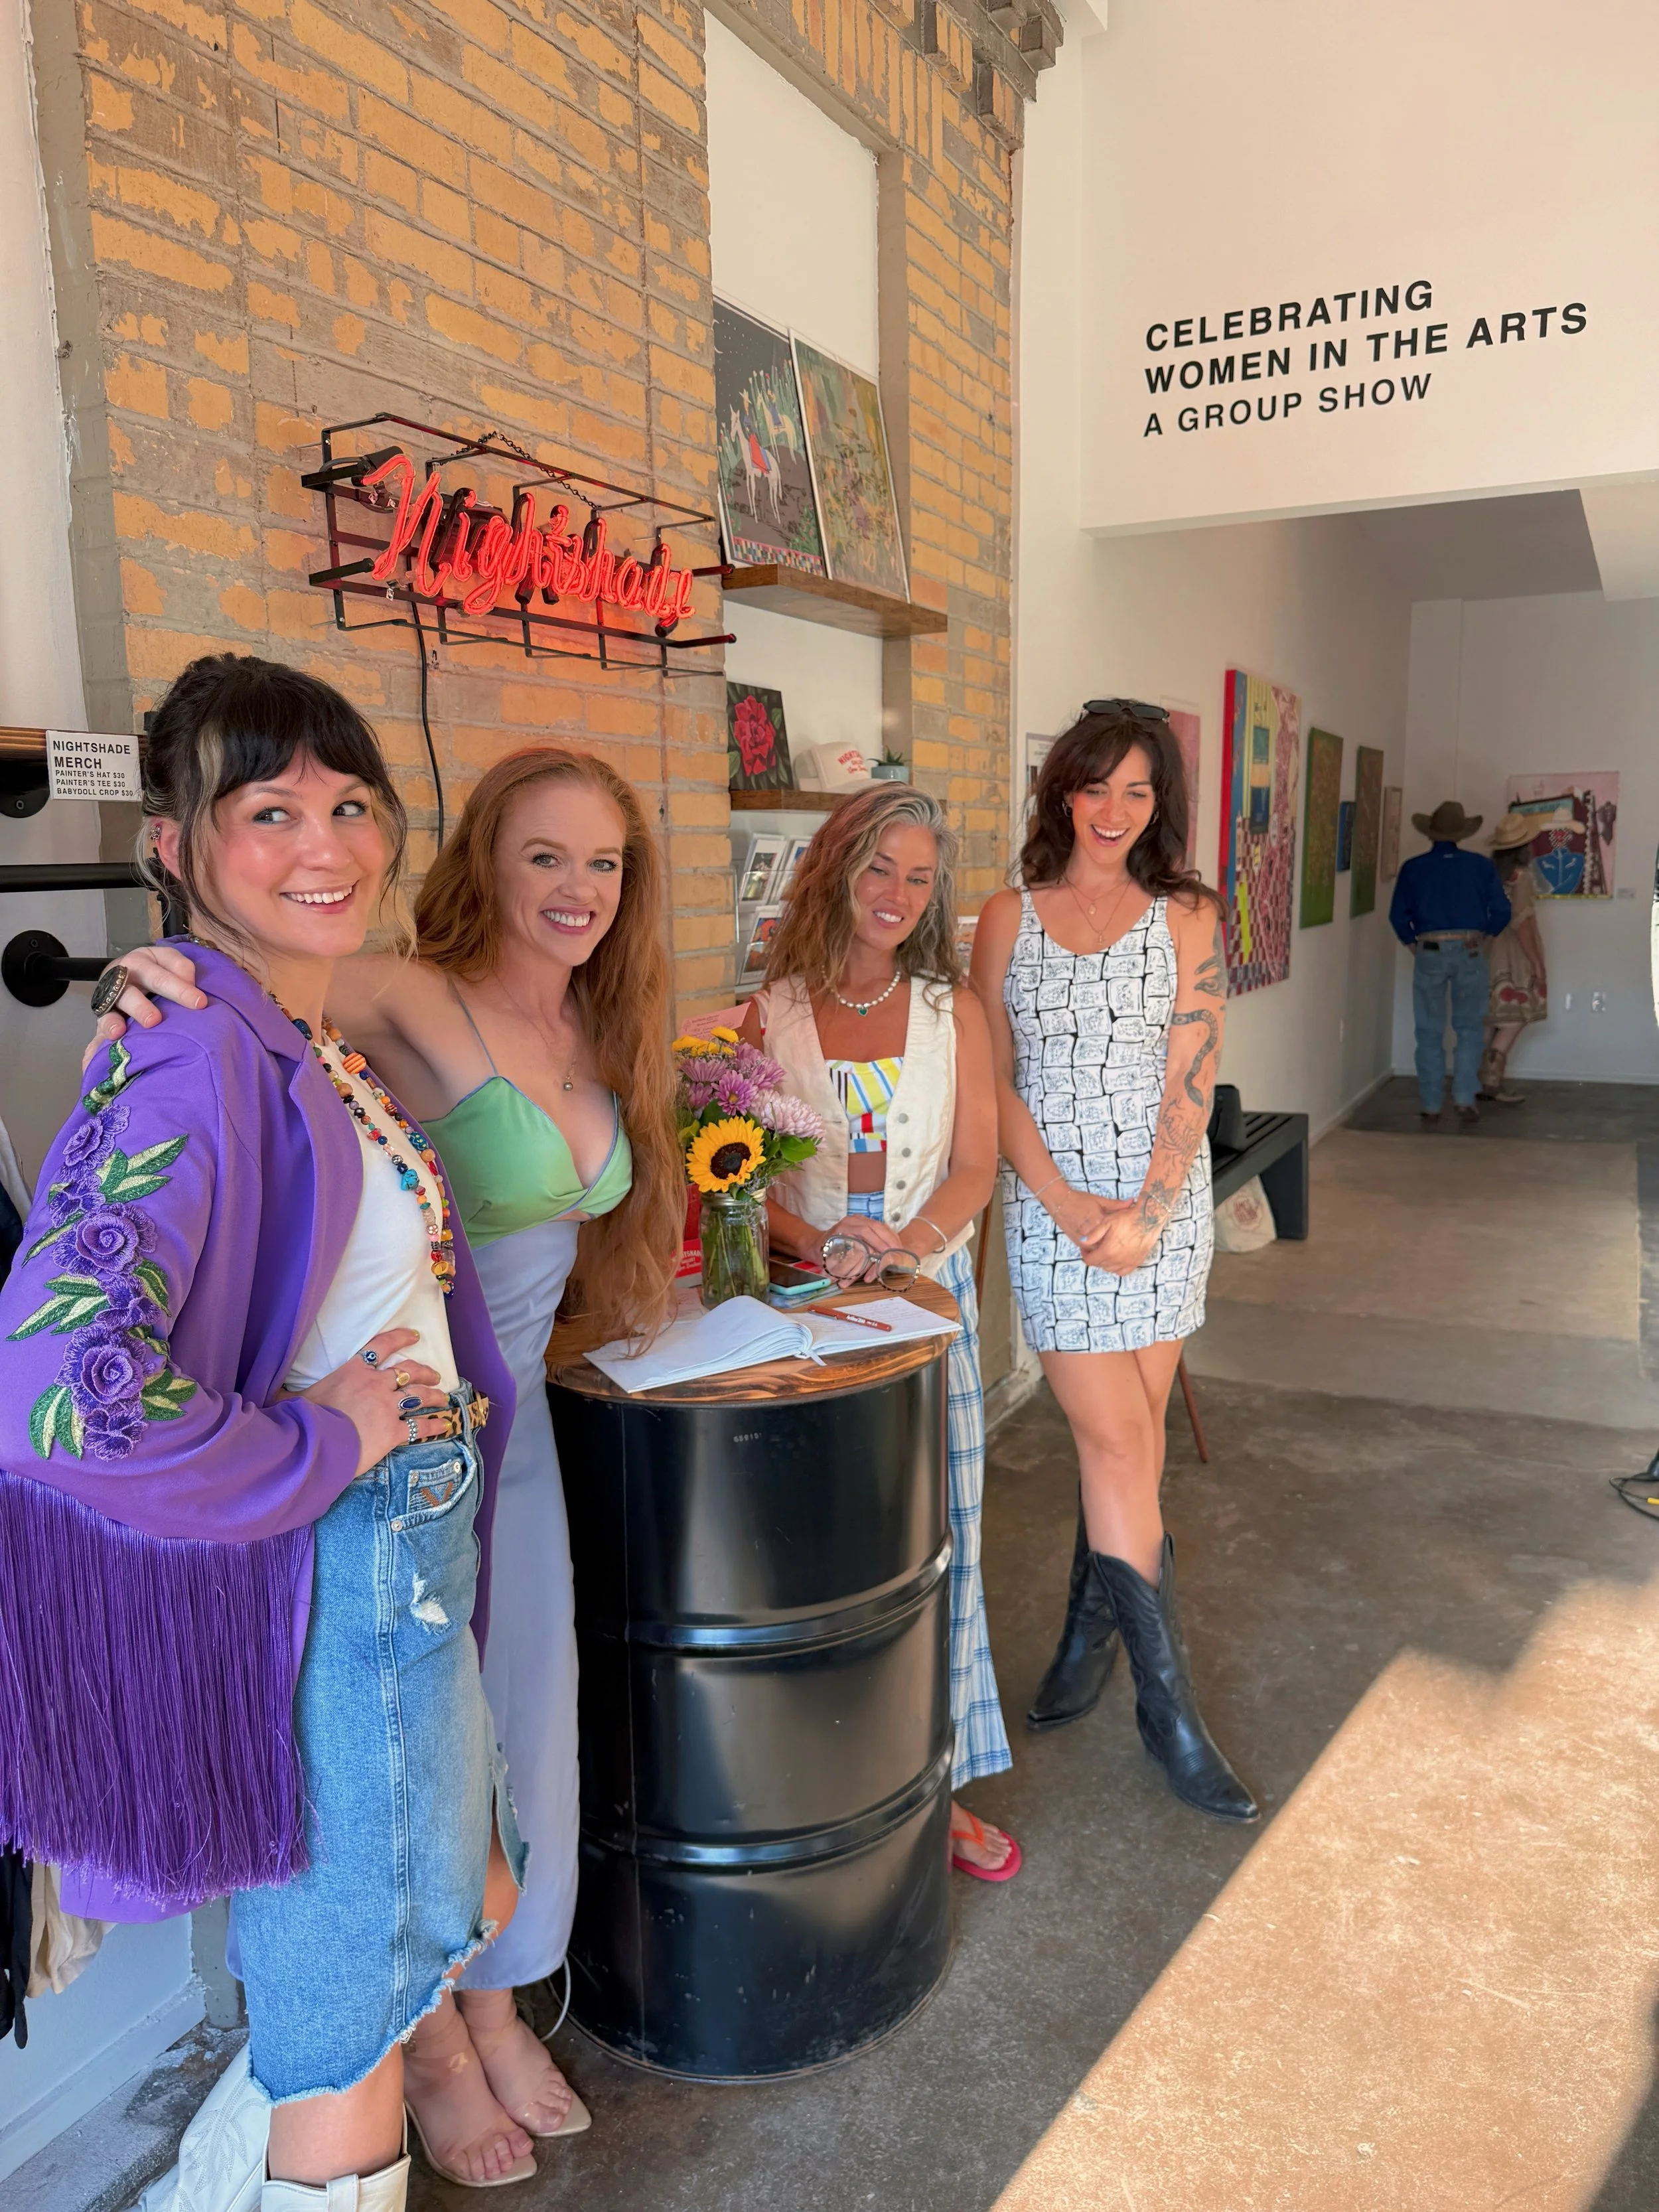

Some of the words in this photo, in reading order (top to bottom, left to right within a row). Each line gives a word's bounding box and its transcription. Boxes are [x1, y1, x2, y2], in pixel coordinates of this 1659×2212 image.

[1146, 280, 1433, 351] CELEBRATING
[1144, 347, 1291, 394] WOMEN
[1309, 338, 1347, 372] IN
[1366, 323, 1449, 362] THE
[1466, 303, 1587, 348] ARTS
[1143, 412, 1163, 437] A
[1178, 392, 1303, 432] GROUP
[1319, 373, 1431, 413] SHOW
[361, 453, 695, 620] Nightshade
[52, 740, 131, 755] NIGHTSHADE
[54, 756, 102, 769] MERCH
[55, 769, 94, 778] PAINTER'S
[56, 787, 97, 796] BABYDOLL
